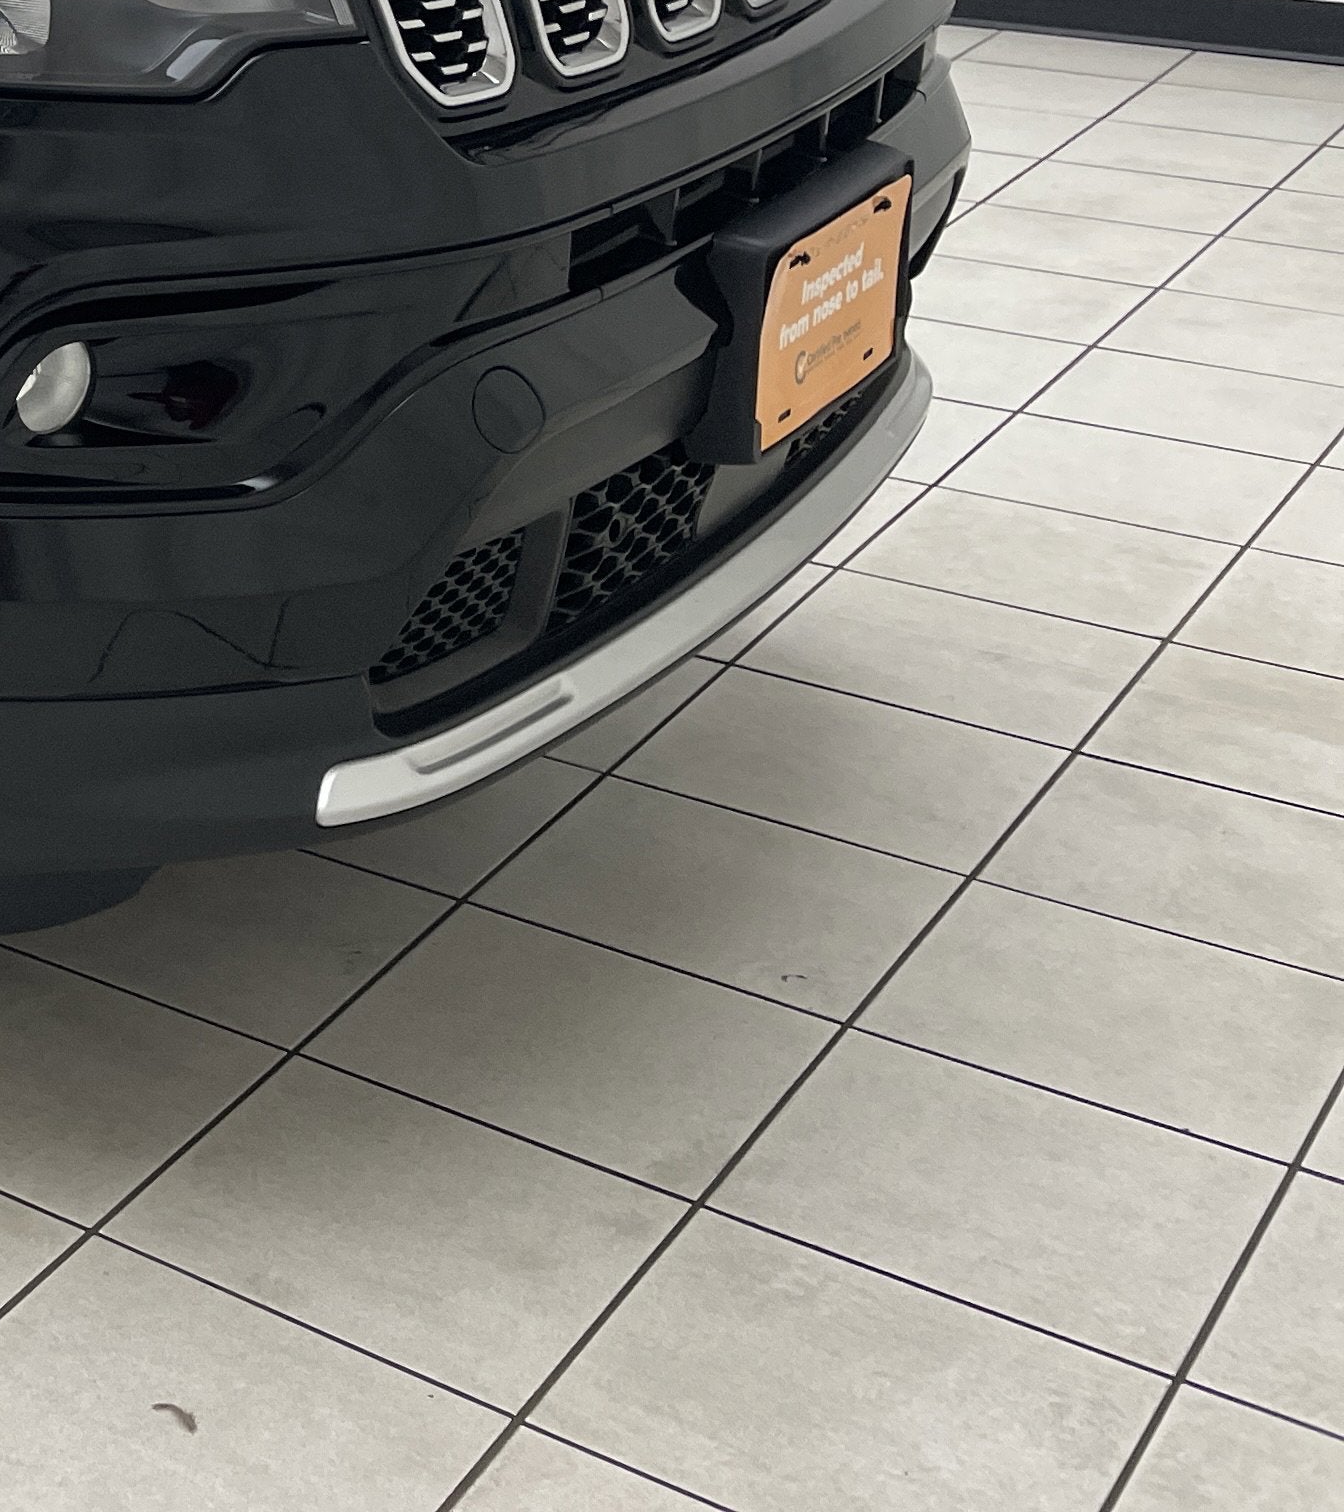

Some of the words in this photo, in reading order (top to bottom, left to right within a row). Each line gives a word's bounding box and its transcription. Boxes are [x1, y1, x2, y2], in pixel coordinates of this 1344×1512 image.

[801, 242, 865, 305] Inspected
[778, 313, 810, 351] from
[812, 292, 844, 328] nose
[845, 279, 859, 303] to
